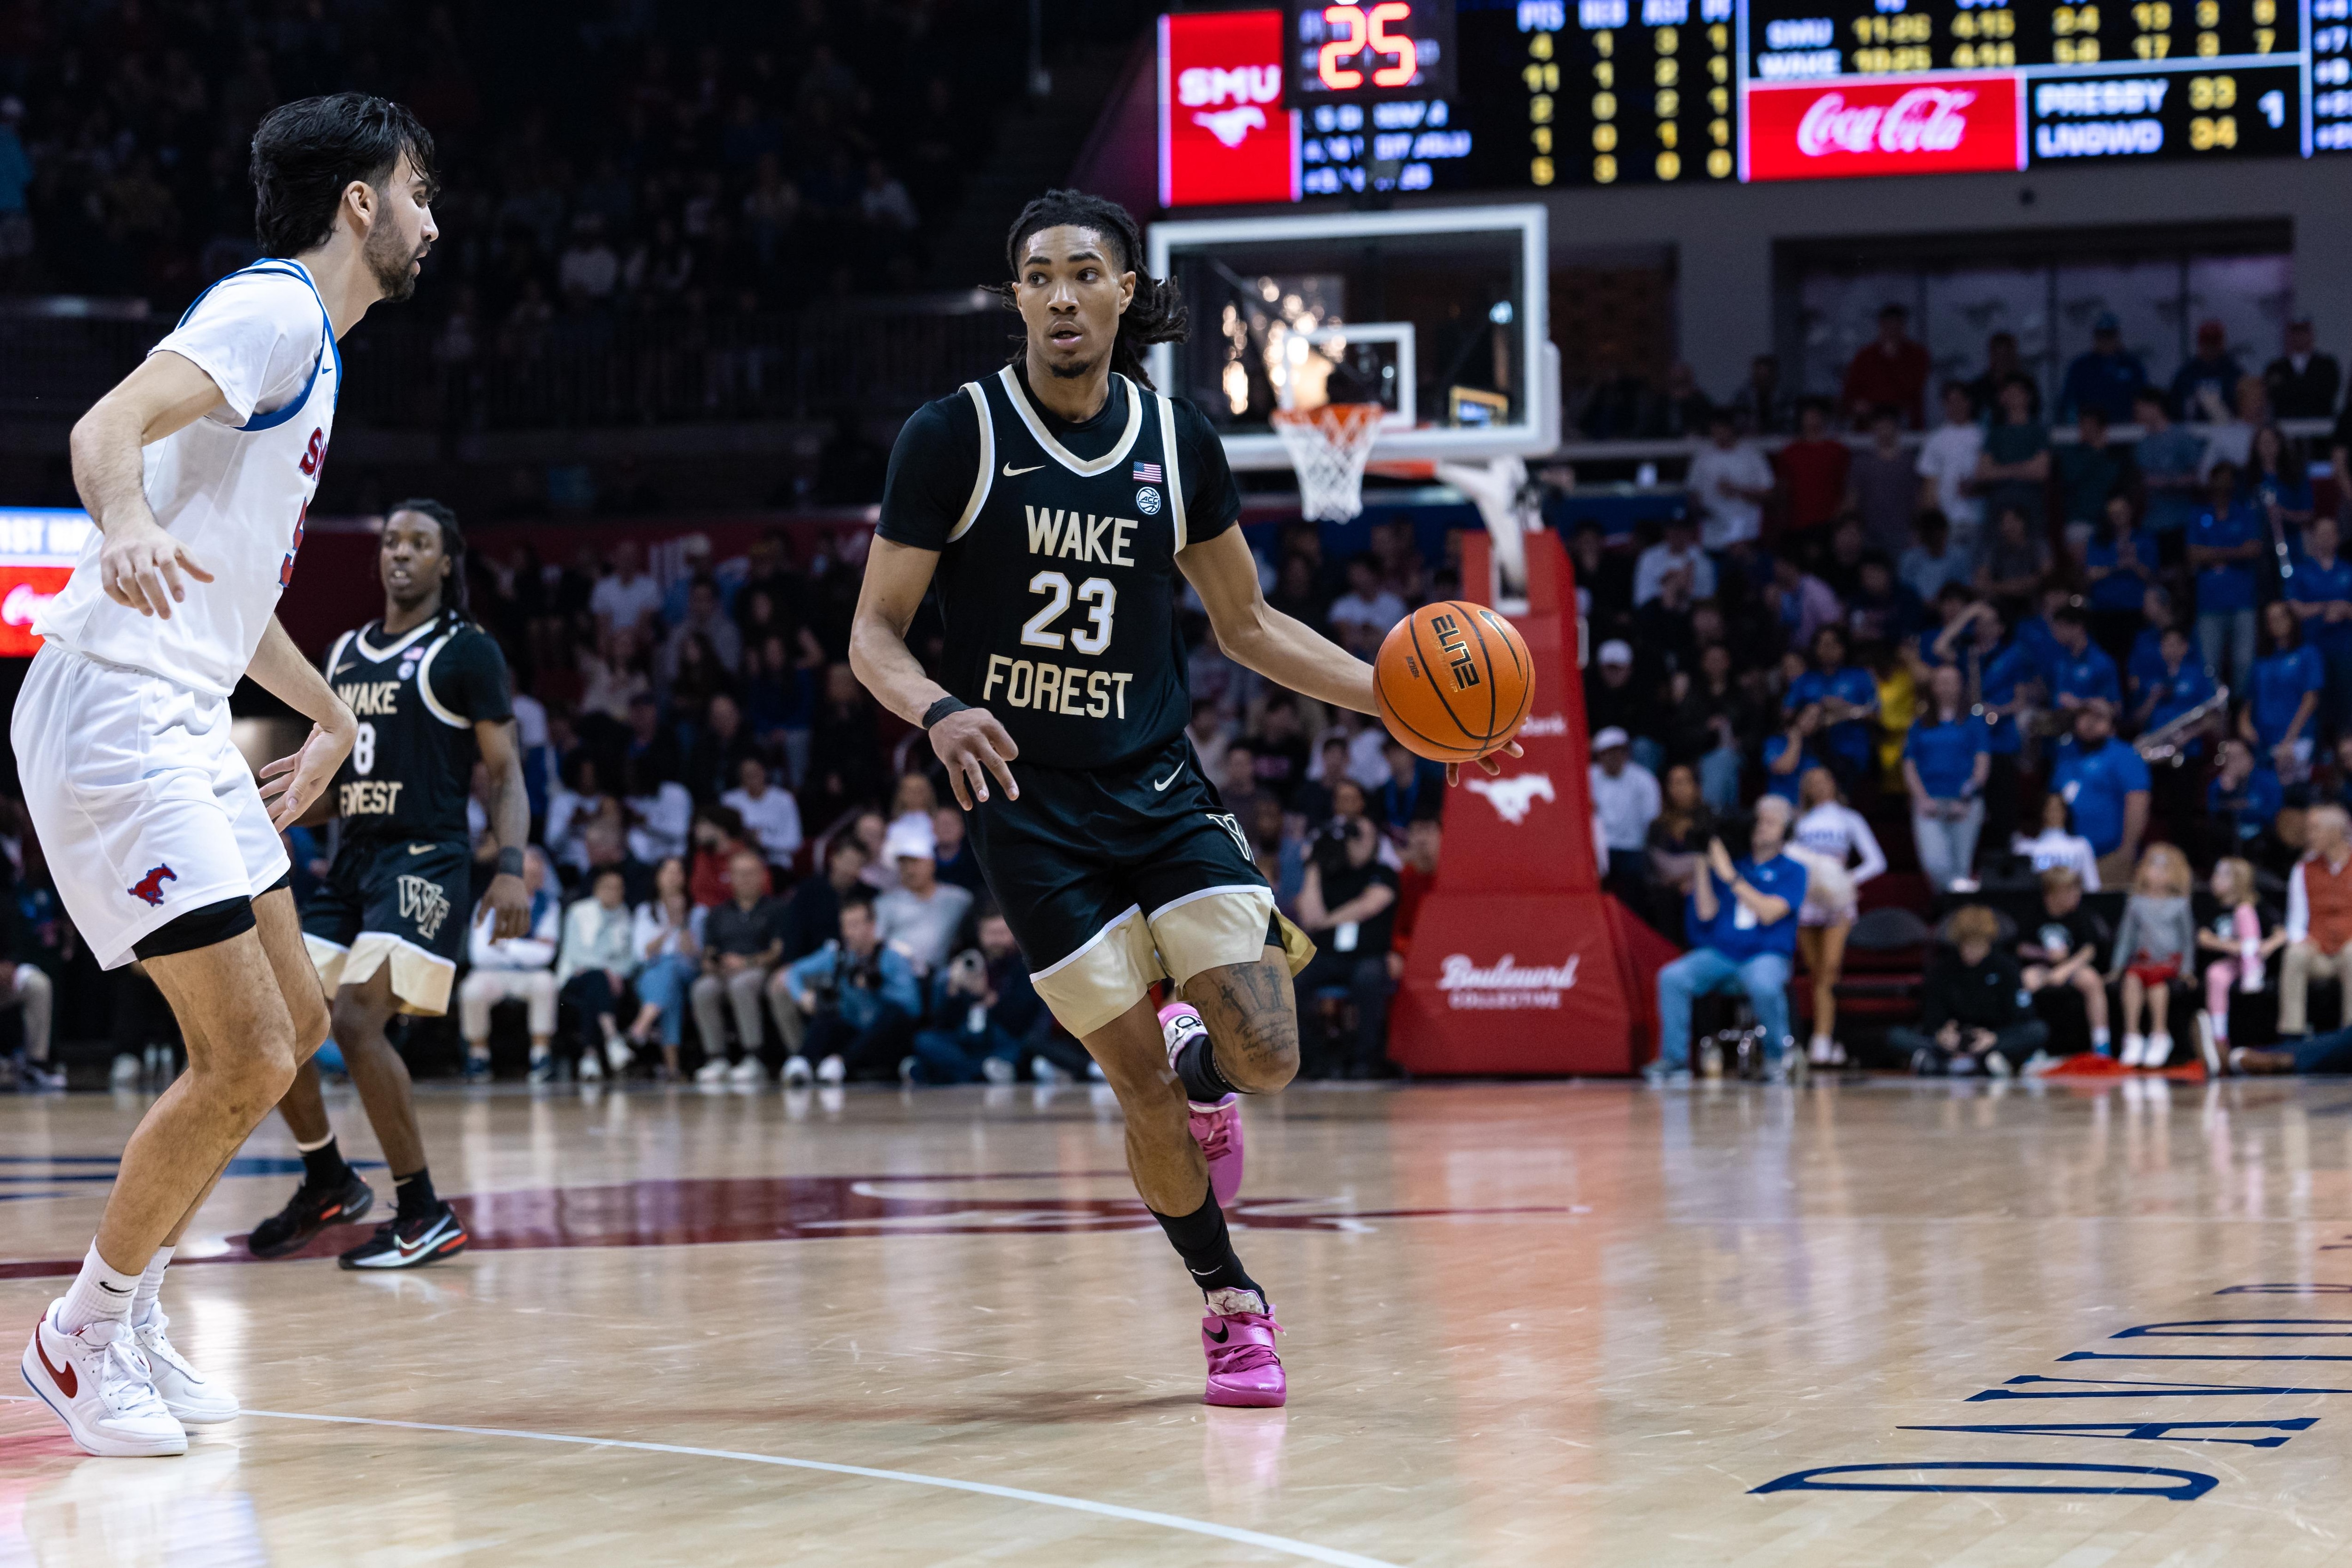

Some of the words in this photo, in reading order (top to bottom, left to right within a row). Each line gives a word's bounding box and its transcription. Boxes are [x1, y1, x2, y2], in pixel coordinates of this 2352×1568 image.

[1318, 1, 1416, 90] 25
[1529, 32, 1553, 61] 4
[1592, 30, 1613, 58] 1
[1707, 23, 1727, 53] 1
[1757, 48, 1842, 77] WAKE
[2131, 33, 2171, 60] 17
[2253, 28, 2276, 55] 7
[1766, 18, 1834, 48] SMU
[1178, 64, 1281, 106] SMU
[1522, 63, 1560, 93] 11
[1592, 60, 1613, 89] 1
[1707, 54, 1728, 84] 1
[1707, 86, 1728, 116] 1
[2257, 90, 2285, 129] 1
[1531, 125, 1552, 154] 1
[1592, 122, 1617, 152] 0
[1656, 119, 1677, 149] 1
[1708, 117, 1729, 147] 1
[1655, 151, 1681, 181] 0
[1706, 148, 1732, 178] 0
[1141, 496, 1159, 505] ACC
[1025, 505, 1138, 567] WAKE
[1020, 571, 1117, 655] 23
[1431, 614, 1481, 691] ELITE
[338, 681, 401, 717] WAKE
[983, 653, 1133, 719] FOREST
[353, 722, 376, 776] 8
[1437, 953, 1581, 990] Boulevard
